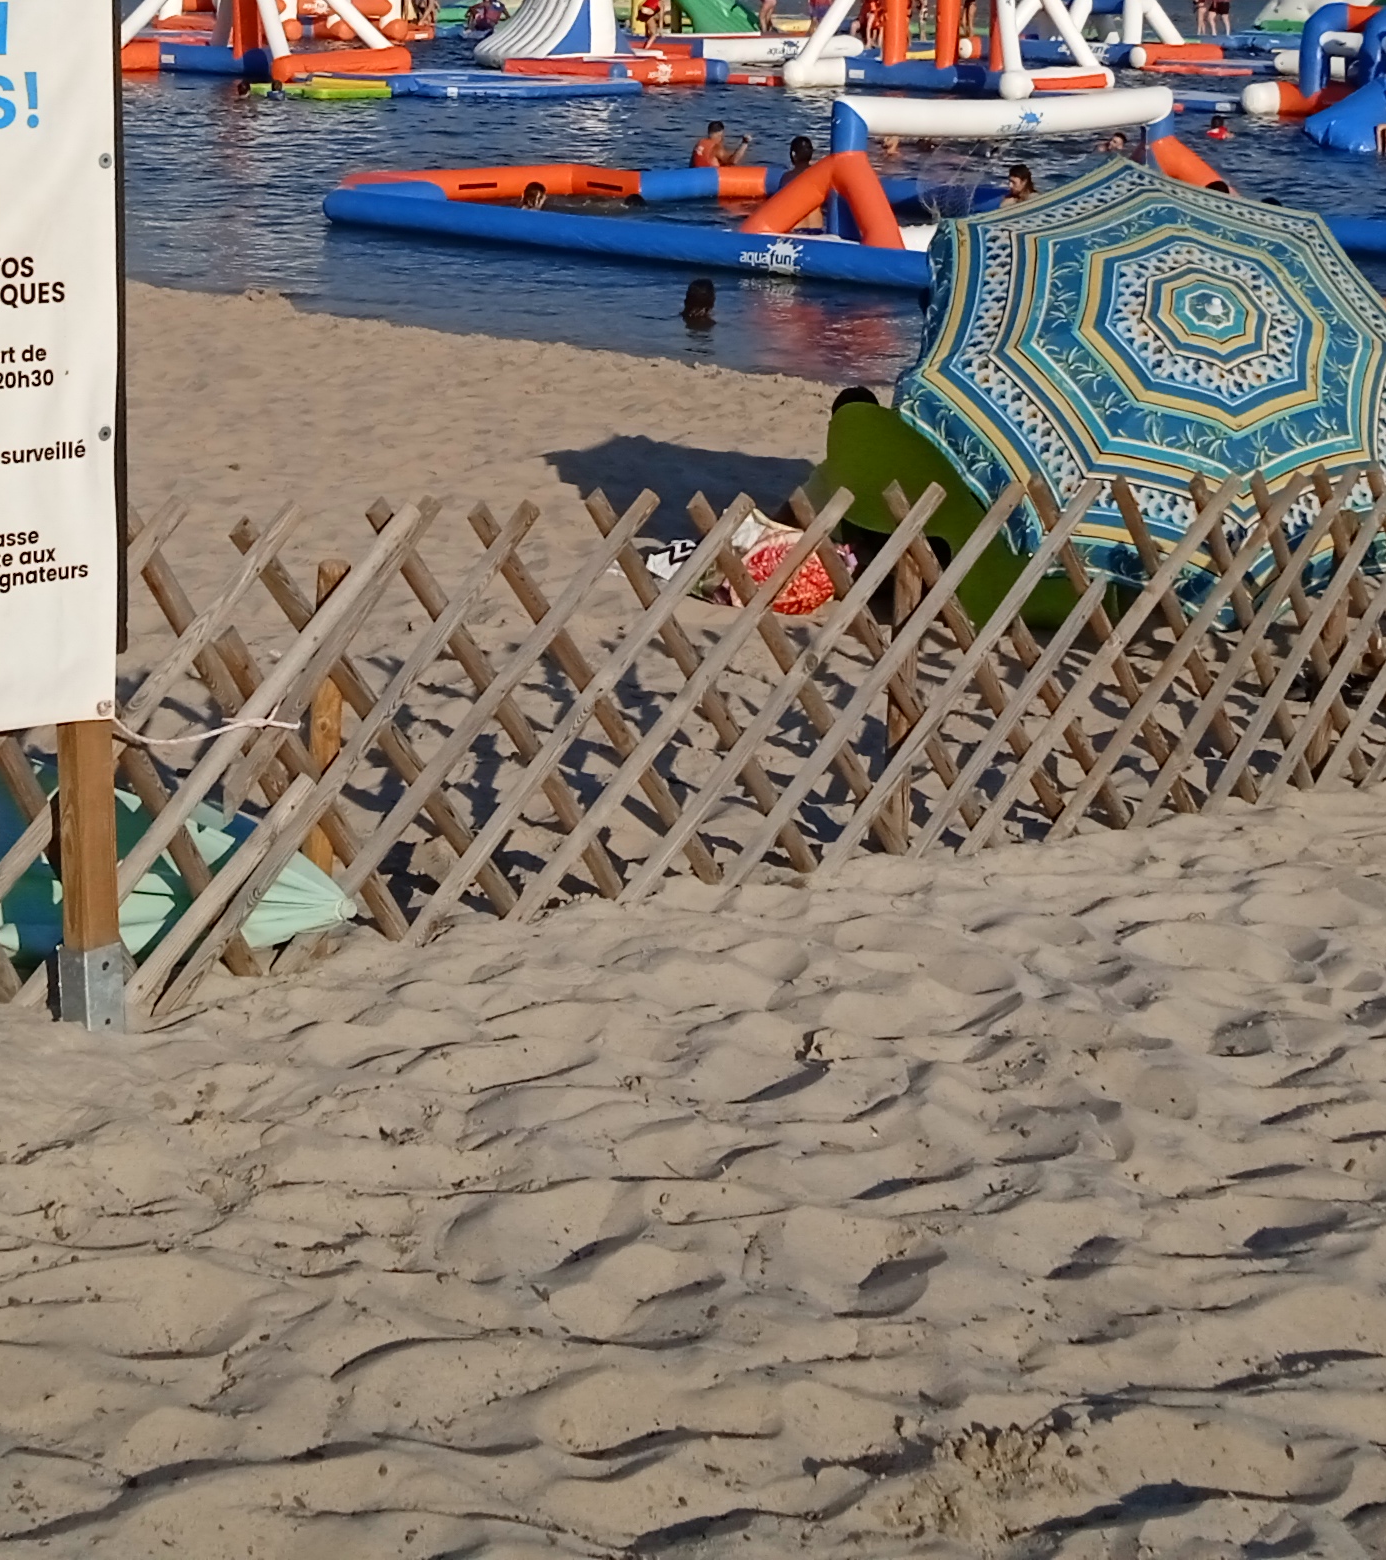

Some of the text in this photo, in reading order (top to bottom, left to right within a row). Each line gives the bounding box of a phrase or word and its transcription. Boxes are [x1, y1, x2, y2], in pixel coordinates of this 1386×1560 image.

[739, 250, 792, 266] aquafun
[21, 344, 47, 362] de
[1, 439, 86, 464] surveillé
[19, 548, 56, 565] aux
